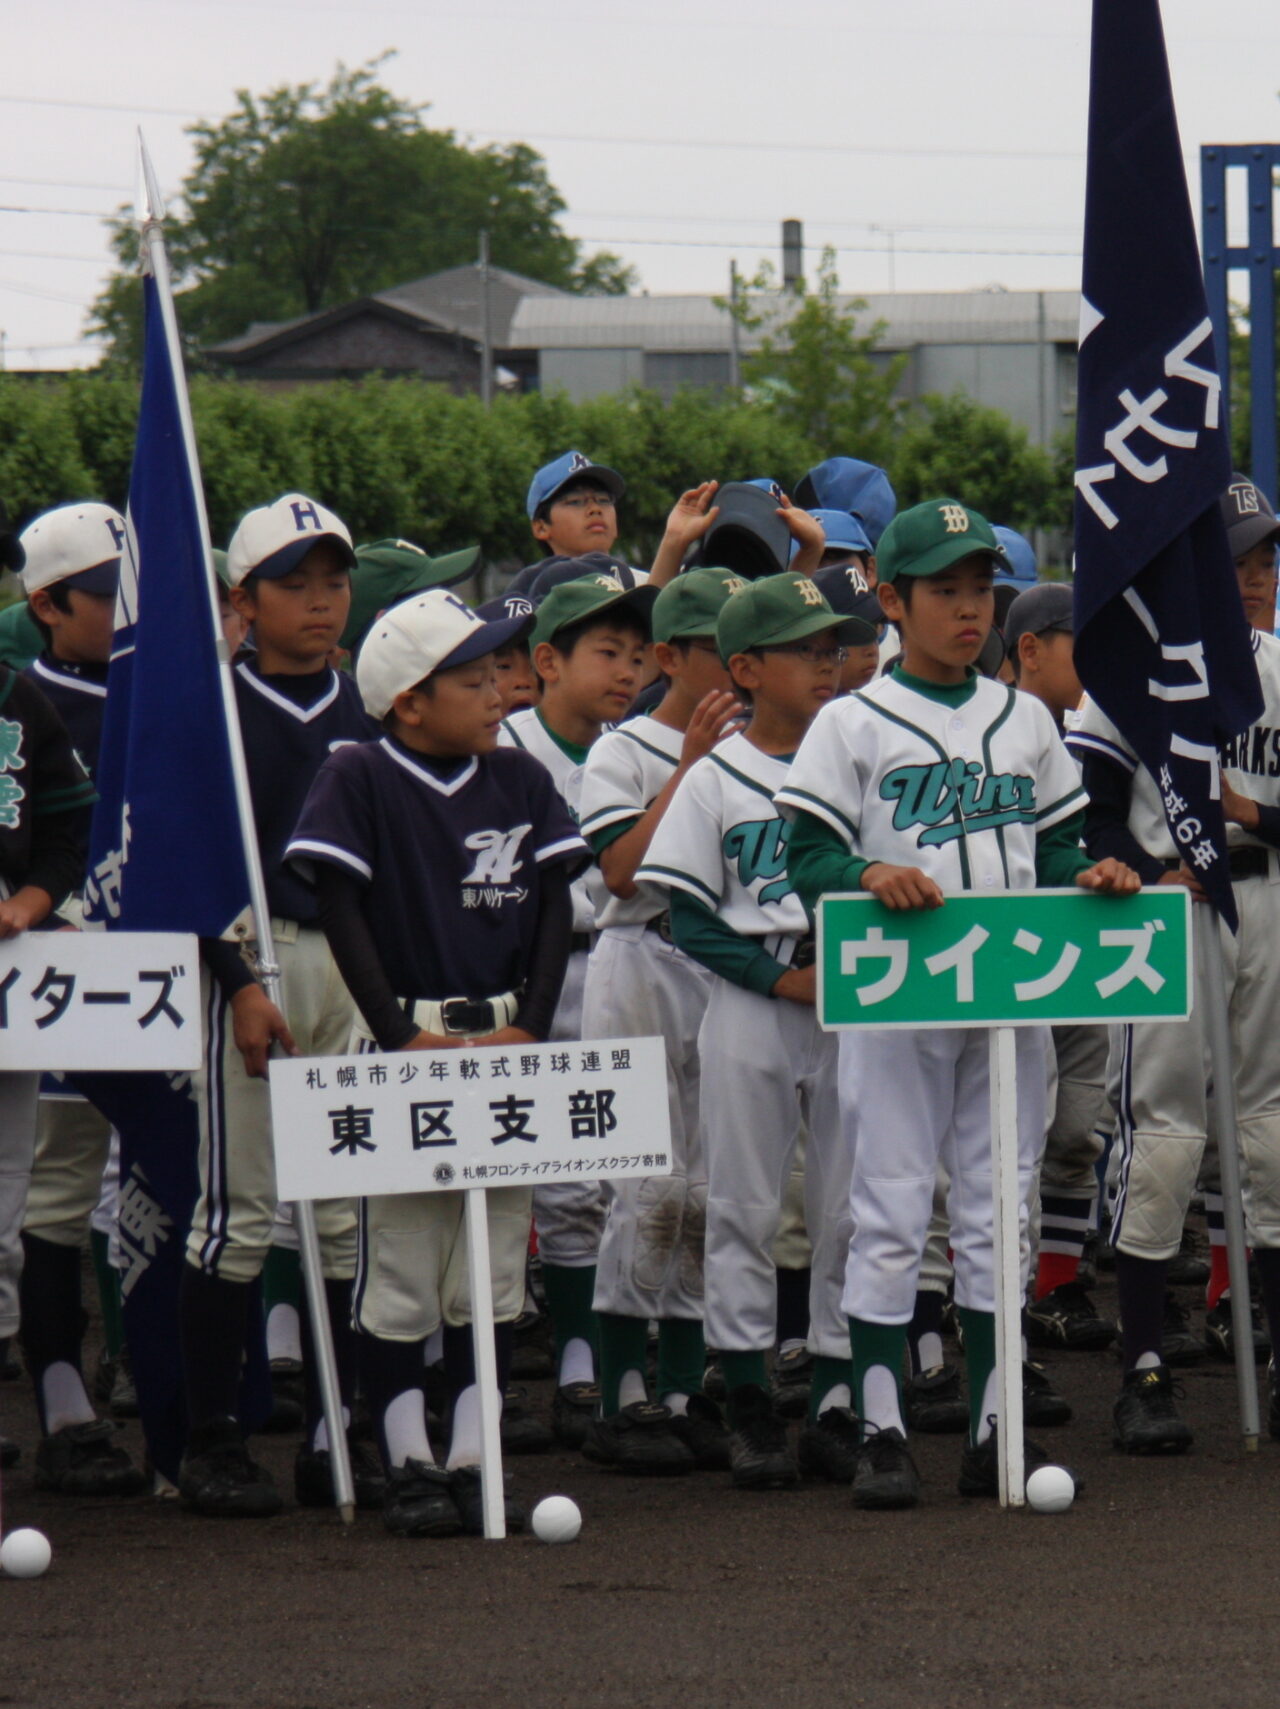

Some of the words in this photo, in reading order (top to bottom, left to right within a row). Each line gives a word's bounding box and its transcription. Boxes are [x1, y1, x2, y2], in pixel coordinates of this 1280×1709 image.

[289, 501, 322, 531] H
[1229, 483, 1260, 514] TS
[838, 918, 1168, 1008] ウインズ
[305, 1048, 633, 1090] 札幌市少年軟式野球連盟
[327, 1088, 619, 1157] 東区支部
[462, 1153, 668, 1181] 札幌フロンティアライオンズクラブ寄贈
